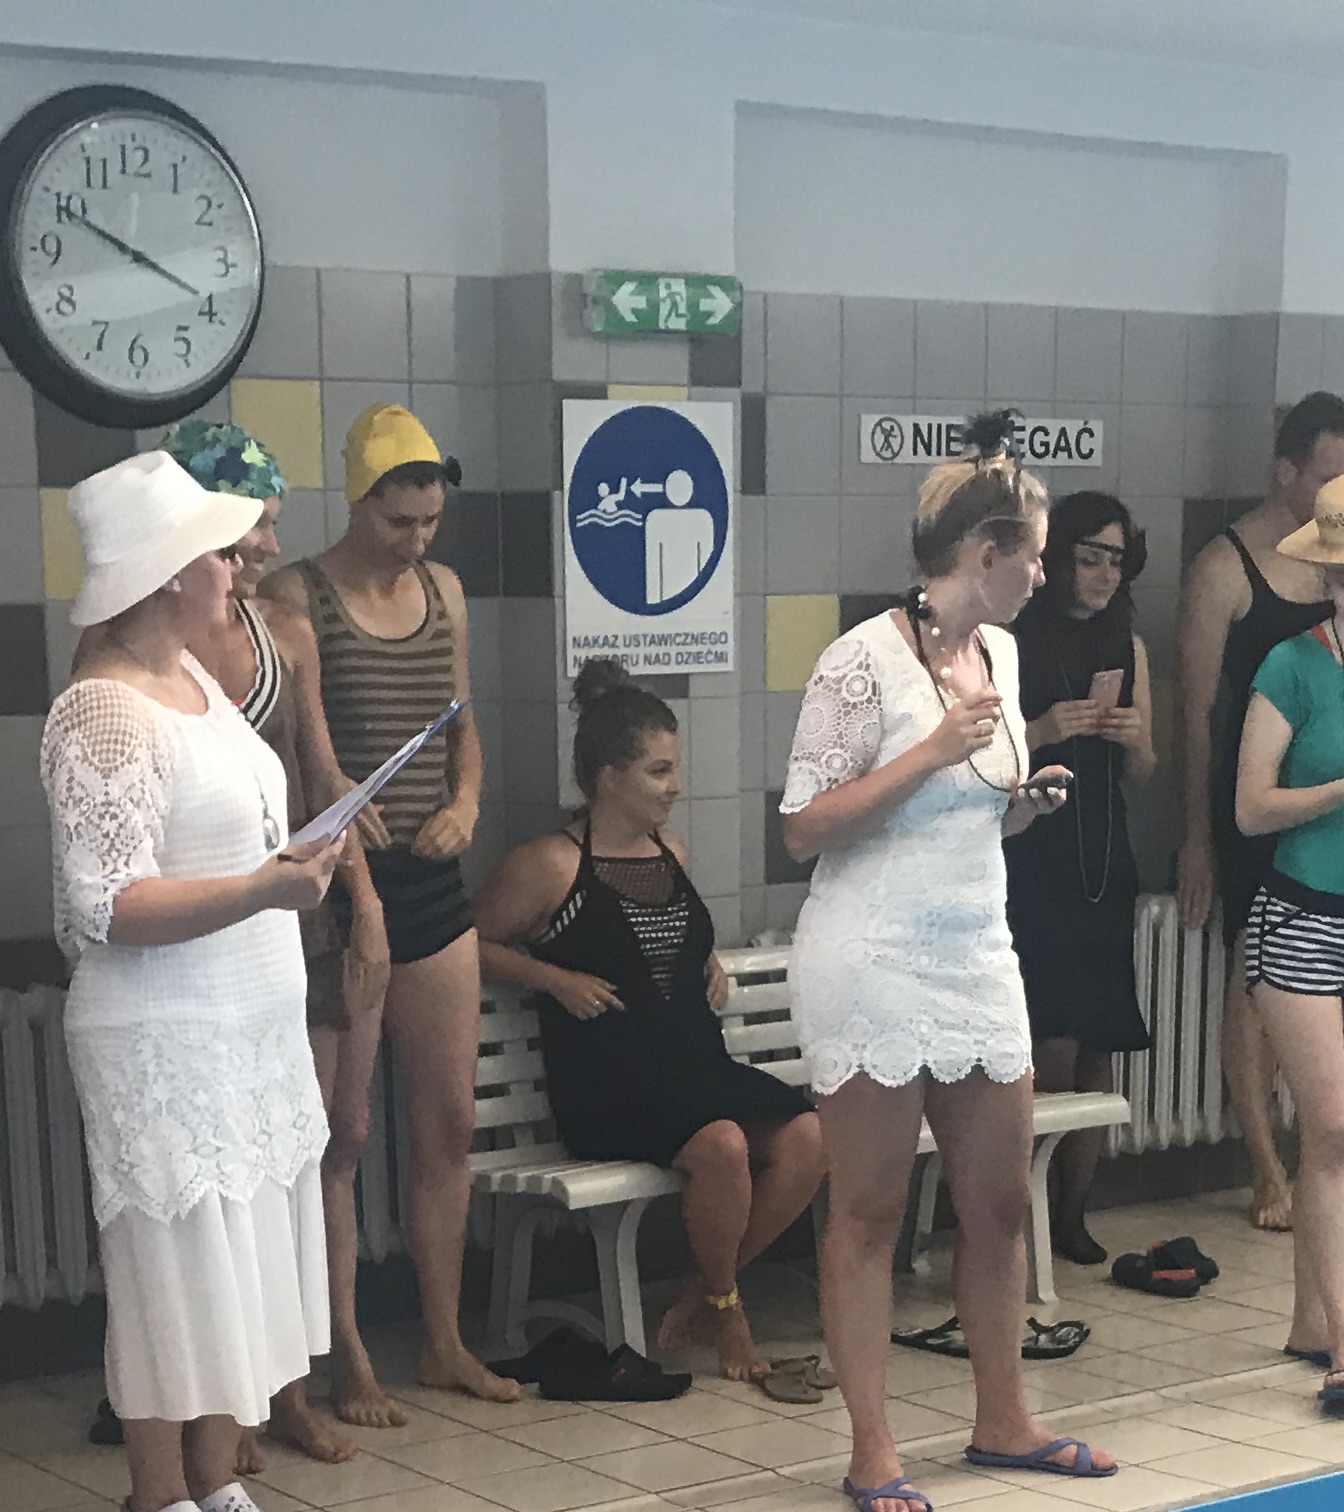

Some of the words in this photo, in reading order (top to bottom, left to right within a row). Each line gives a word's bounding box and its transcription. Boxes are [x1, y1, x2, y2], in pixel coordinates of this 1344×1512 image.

[84, 155, 108, 189] 11
[120, 143, 152, 178] 12
[170, 162, 179, 195] 1
[55, 190, 87, 224] 10
[194, 194, 214, 227] 2
[40, 230, 62, 266] 9
[213, 245, 230, 279] 3
[55, 284, 77, 317] 8
[197, 292, 219, 324] 4
[91, 320, 110, 351] 7
[127, 333, 150, 369] 6
[173, 325, 192, 358] 5
[912, 422, 965, 457] NIE
[977, 419, 1095, 460] EGAĆ
[572, 634, 620, 649] NAKAZ
[622, 631, 729, 648] USTAWICZNEGO
[643, 652, 671, 666] NAD
[674, 649, 729, 666] DZIEĆMI
